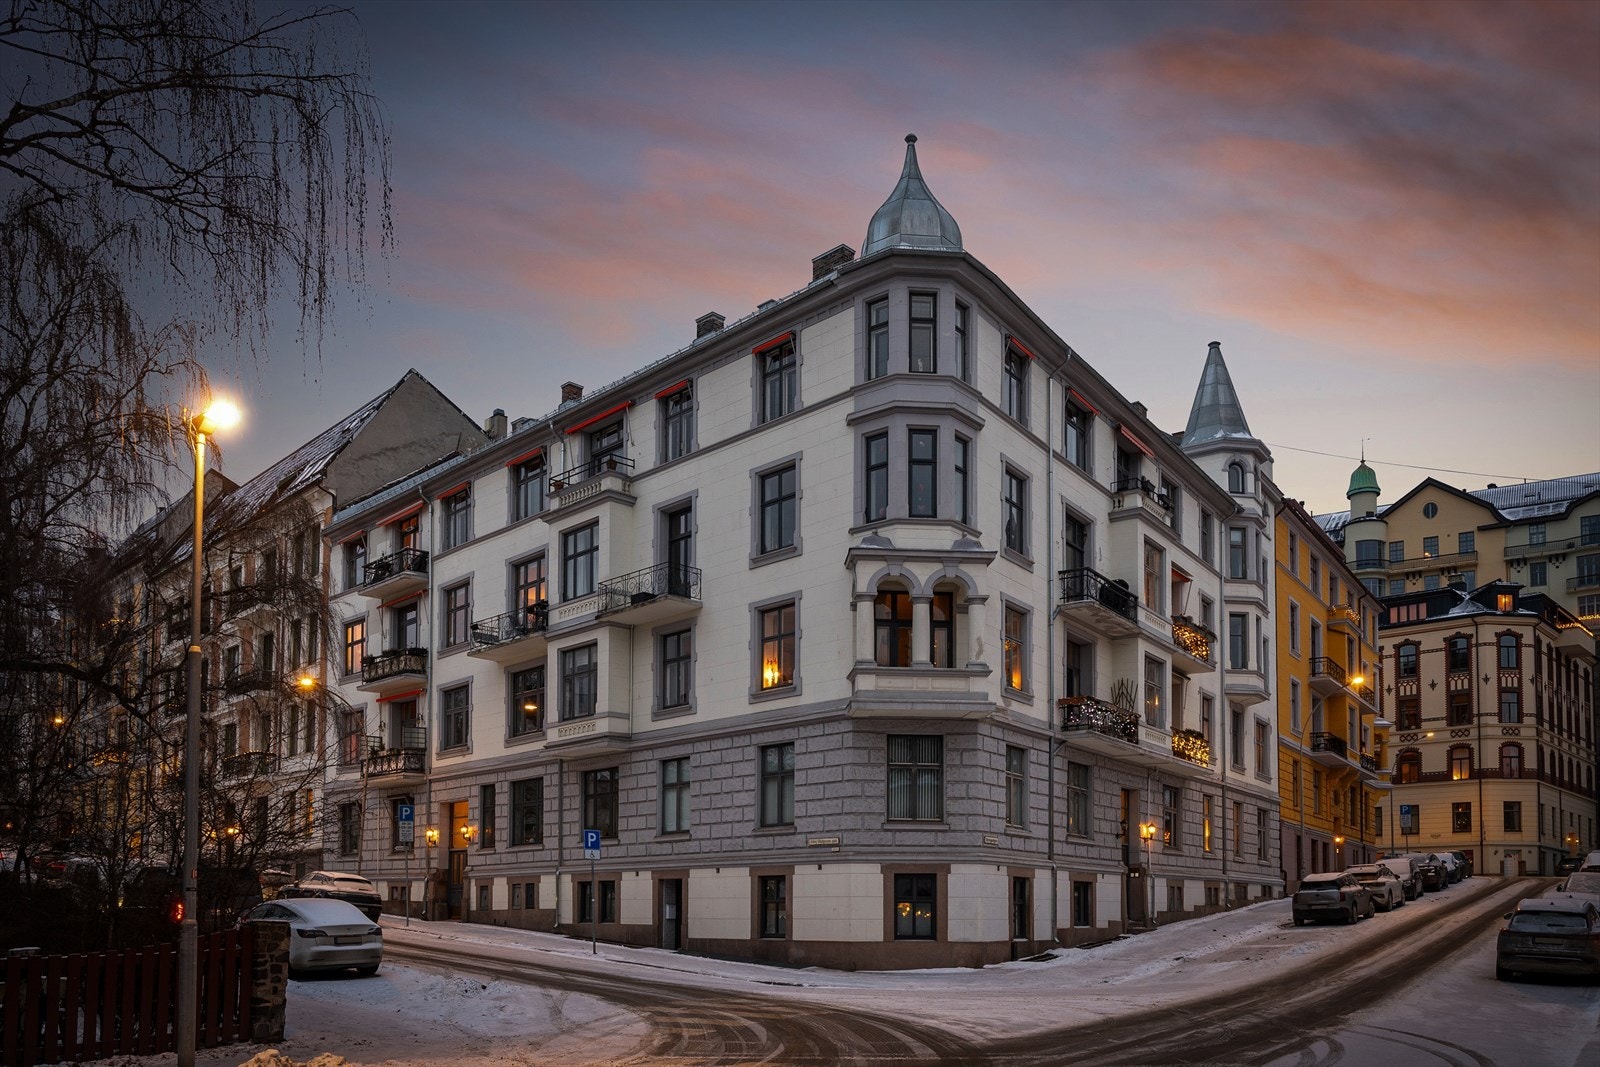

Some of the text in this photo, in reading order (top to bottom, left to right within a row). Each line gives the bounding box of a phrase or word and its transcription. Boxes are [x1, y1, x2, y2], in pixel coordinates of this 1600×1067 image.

[402, 807, 411, 819] P
[1402, 806, 1408, 814] P
[588, 833, 596, 847] P
